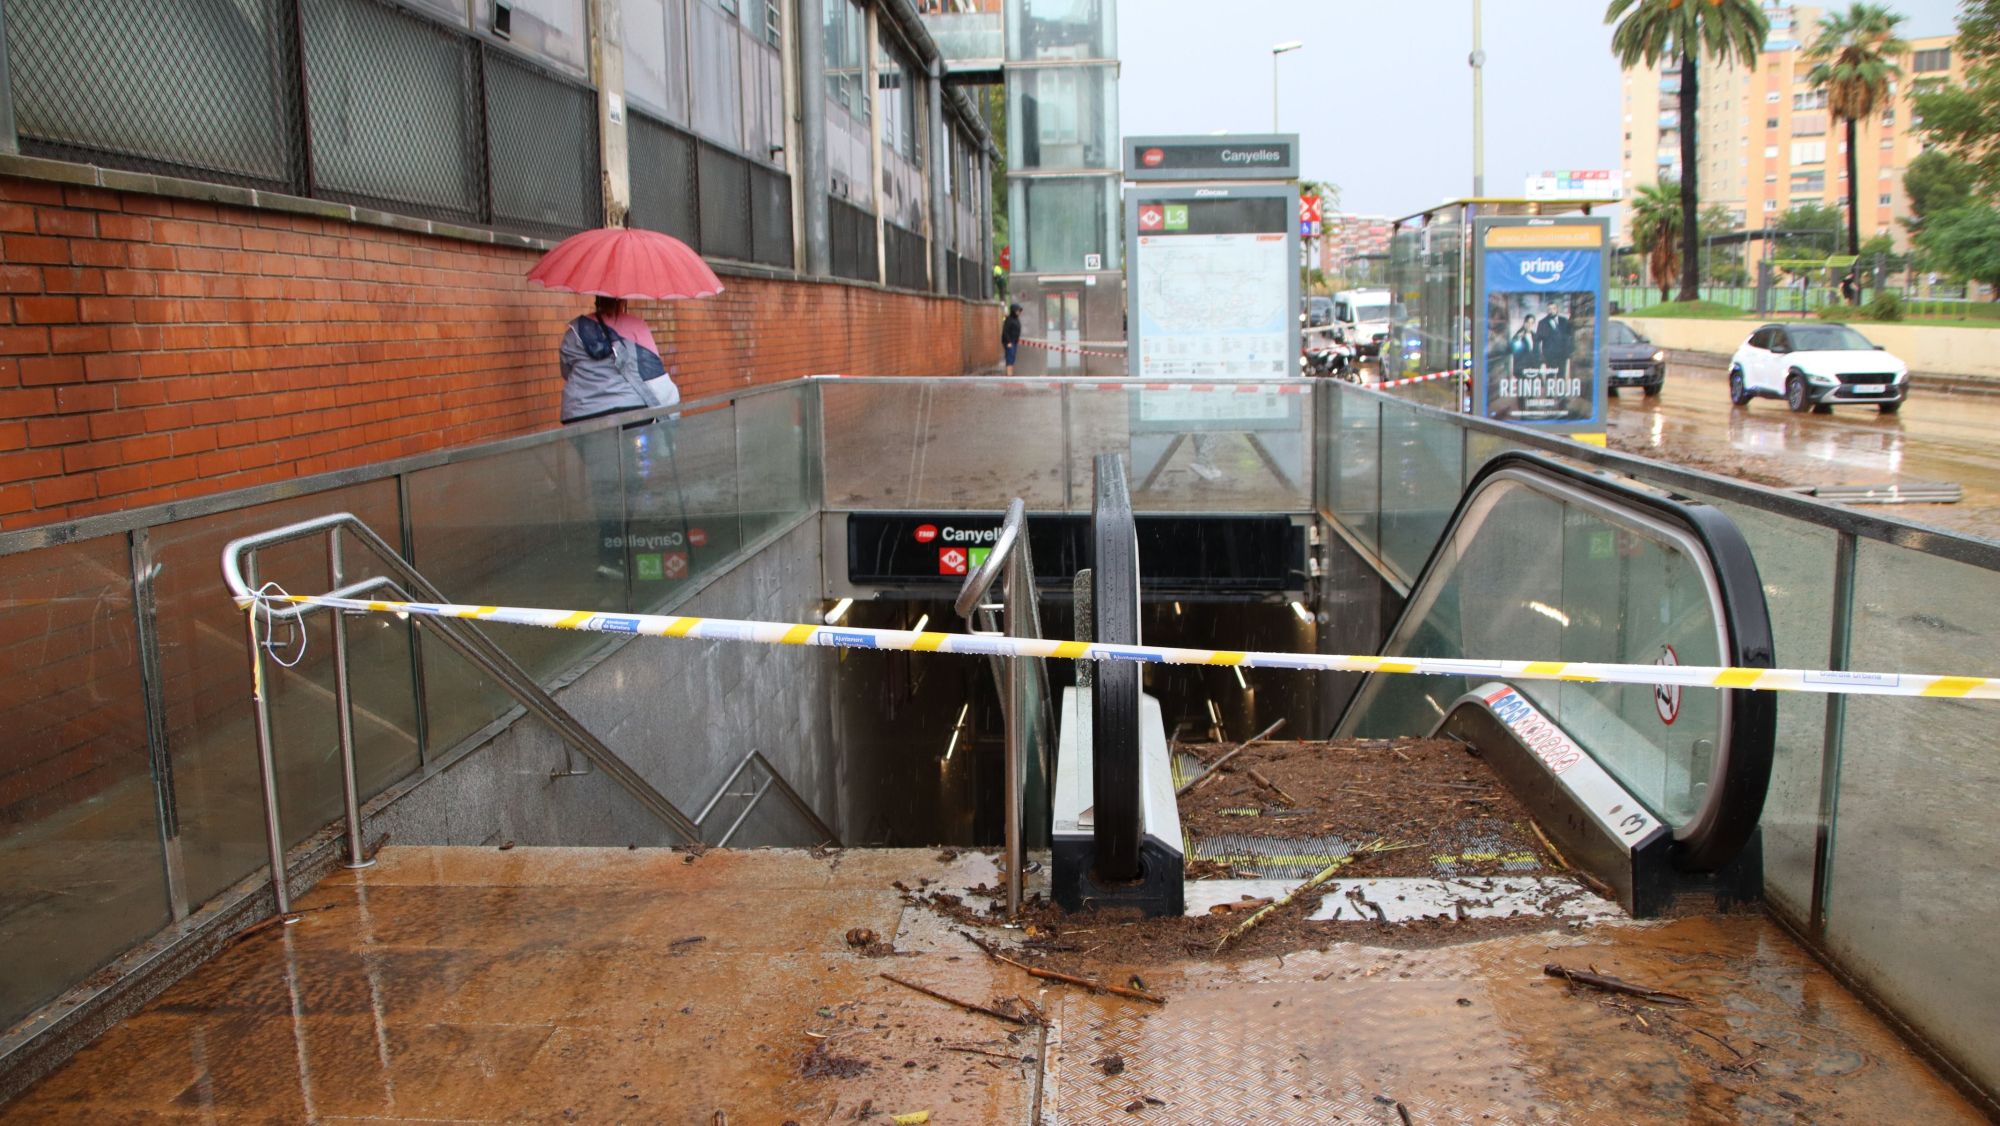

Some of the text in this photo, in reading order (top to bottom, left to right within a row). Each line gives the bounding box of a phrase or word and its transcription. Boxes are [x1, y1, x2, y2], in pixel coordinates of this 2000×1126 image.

[1221, 149, 1280, 163] Canyelles
[1166, 209, 1187, 225] L3
[1521, 257, 1565, 275] prime
[1499, 378, 1581, 397] REINA ROJA
